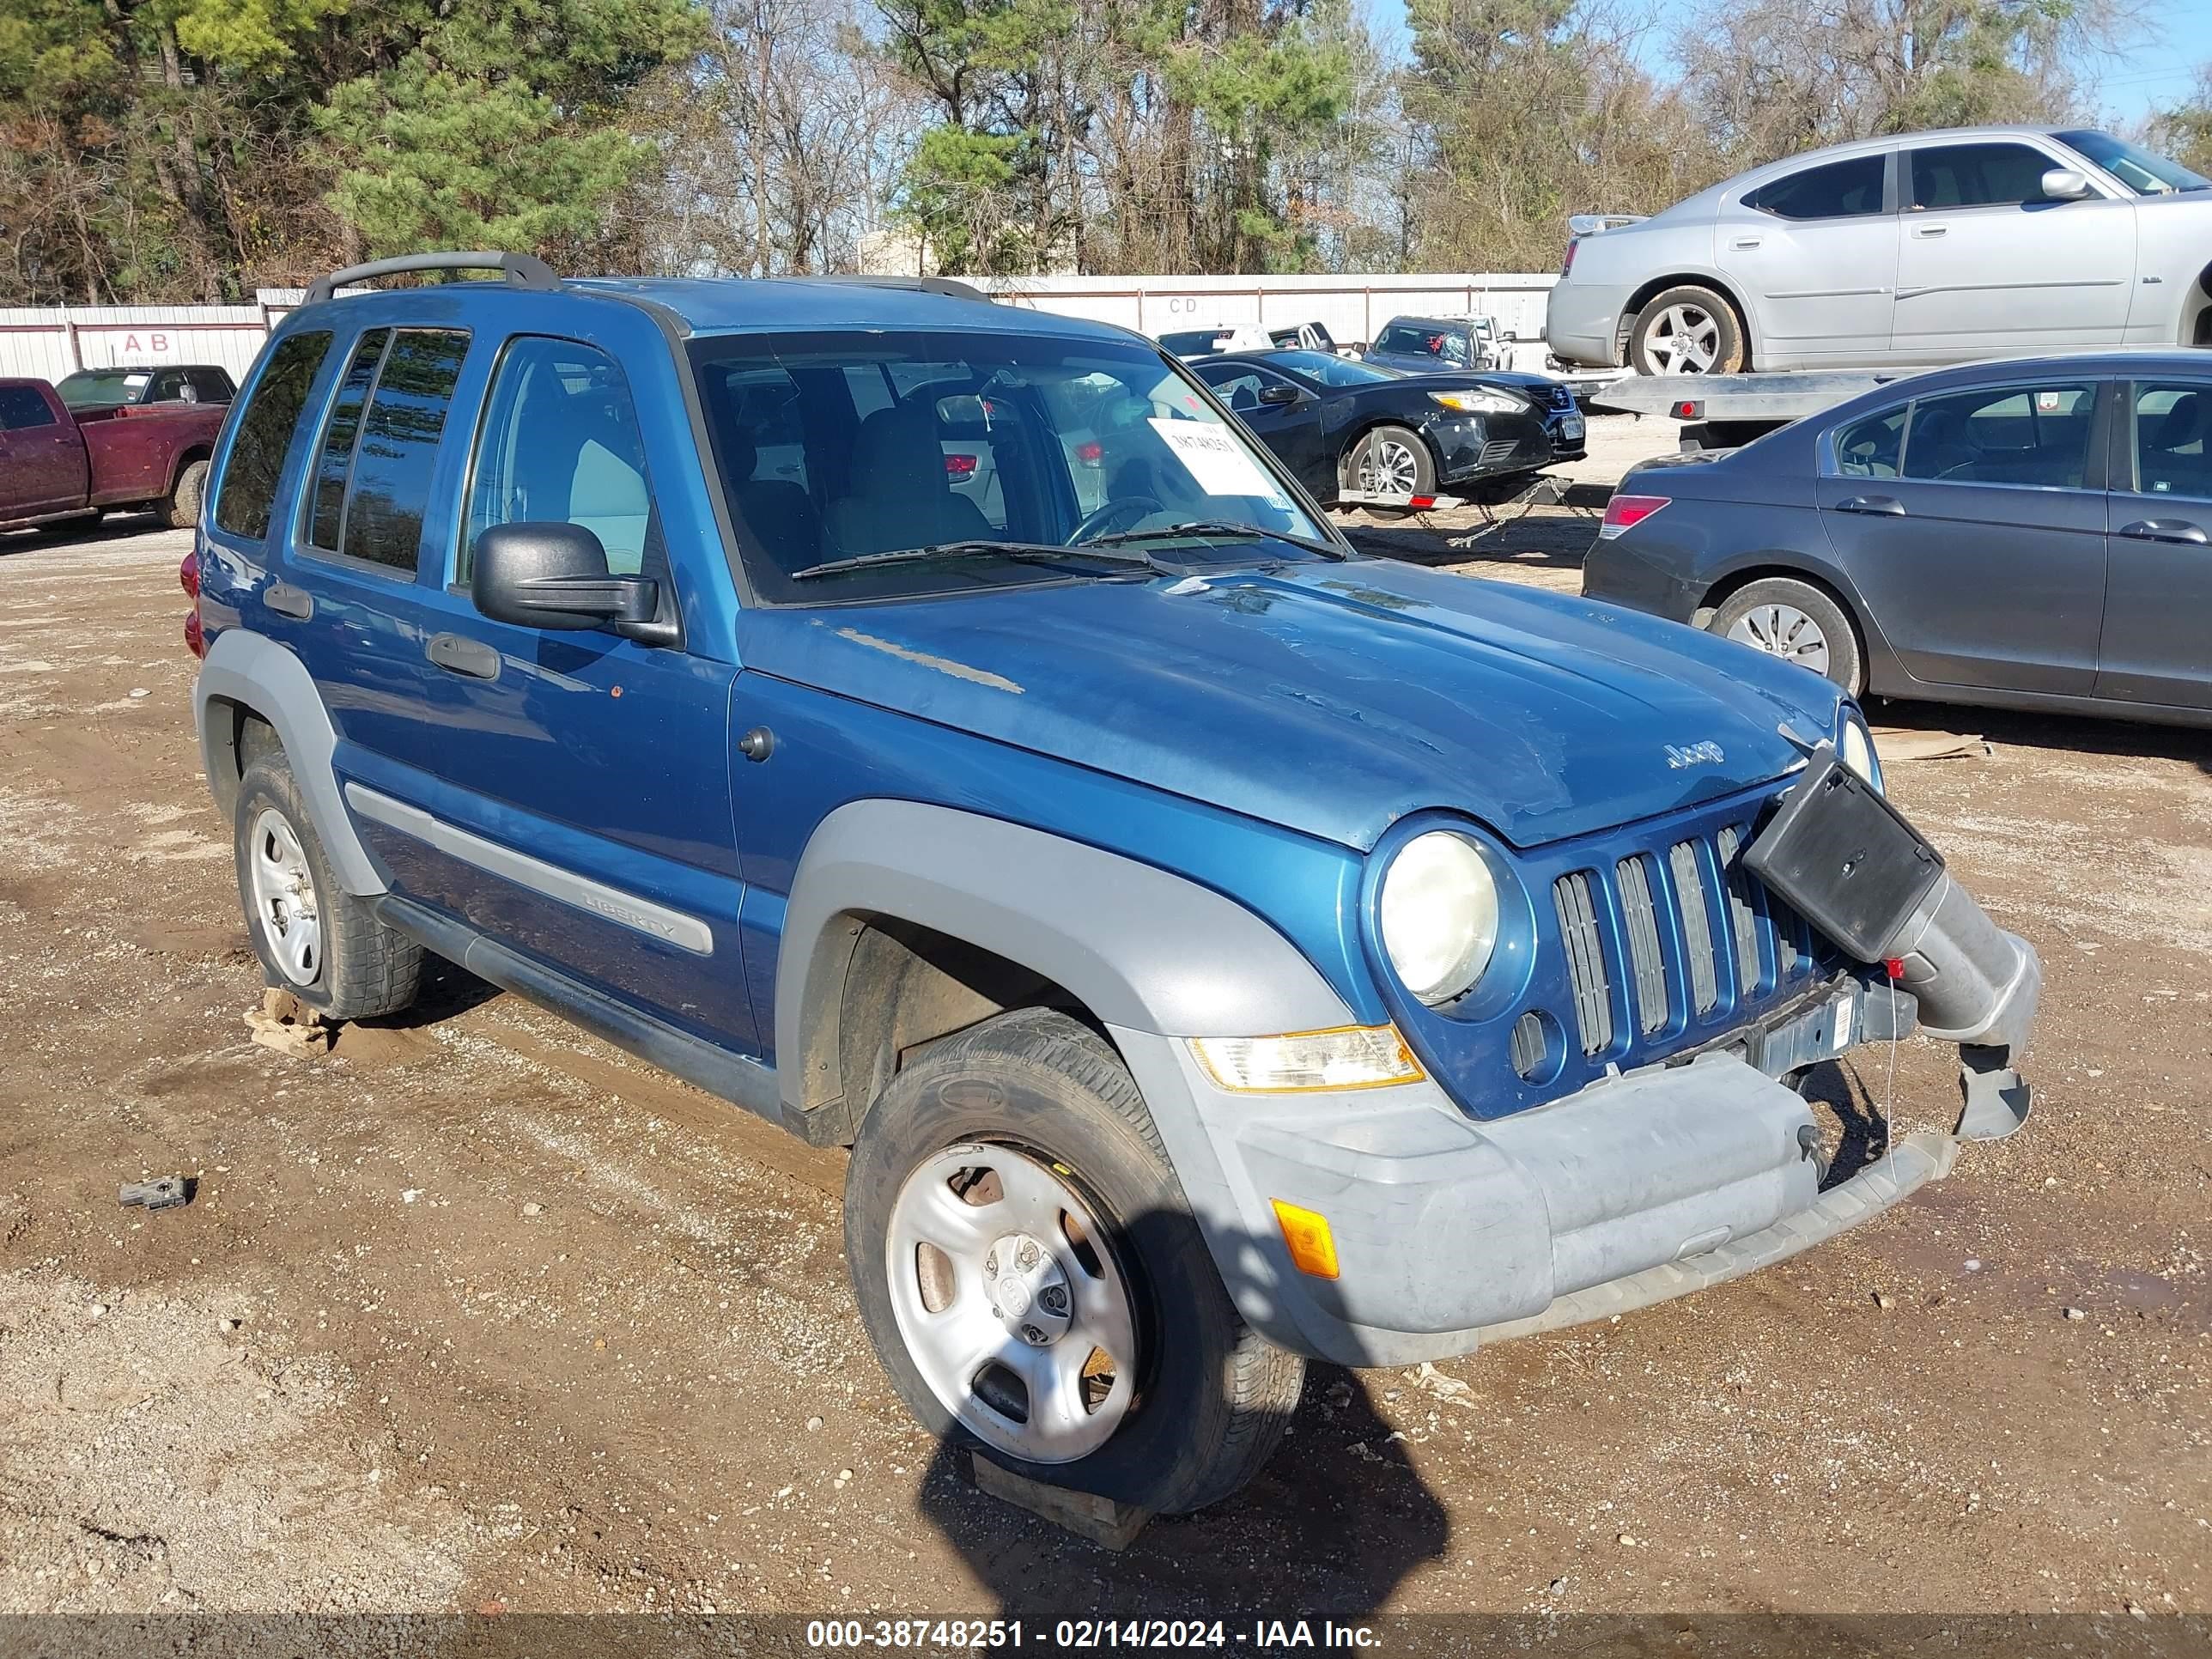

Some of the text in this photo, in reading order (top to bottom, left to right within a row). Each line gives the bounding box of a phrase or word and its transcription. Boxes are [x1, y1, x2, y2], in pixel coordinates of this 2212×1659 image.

[125, 333, 168, 352] A B
[1170, 434, 1235, 453] 38748251
[1662, 739, 1725, 770] Jeep
[583, 893, 675, 937] LIBERTY
